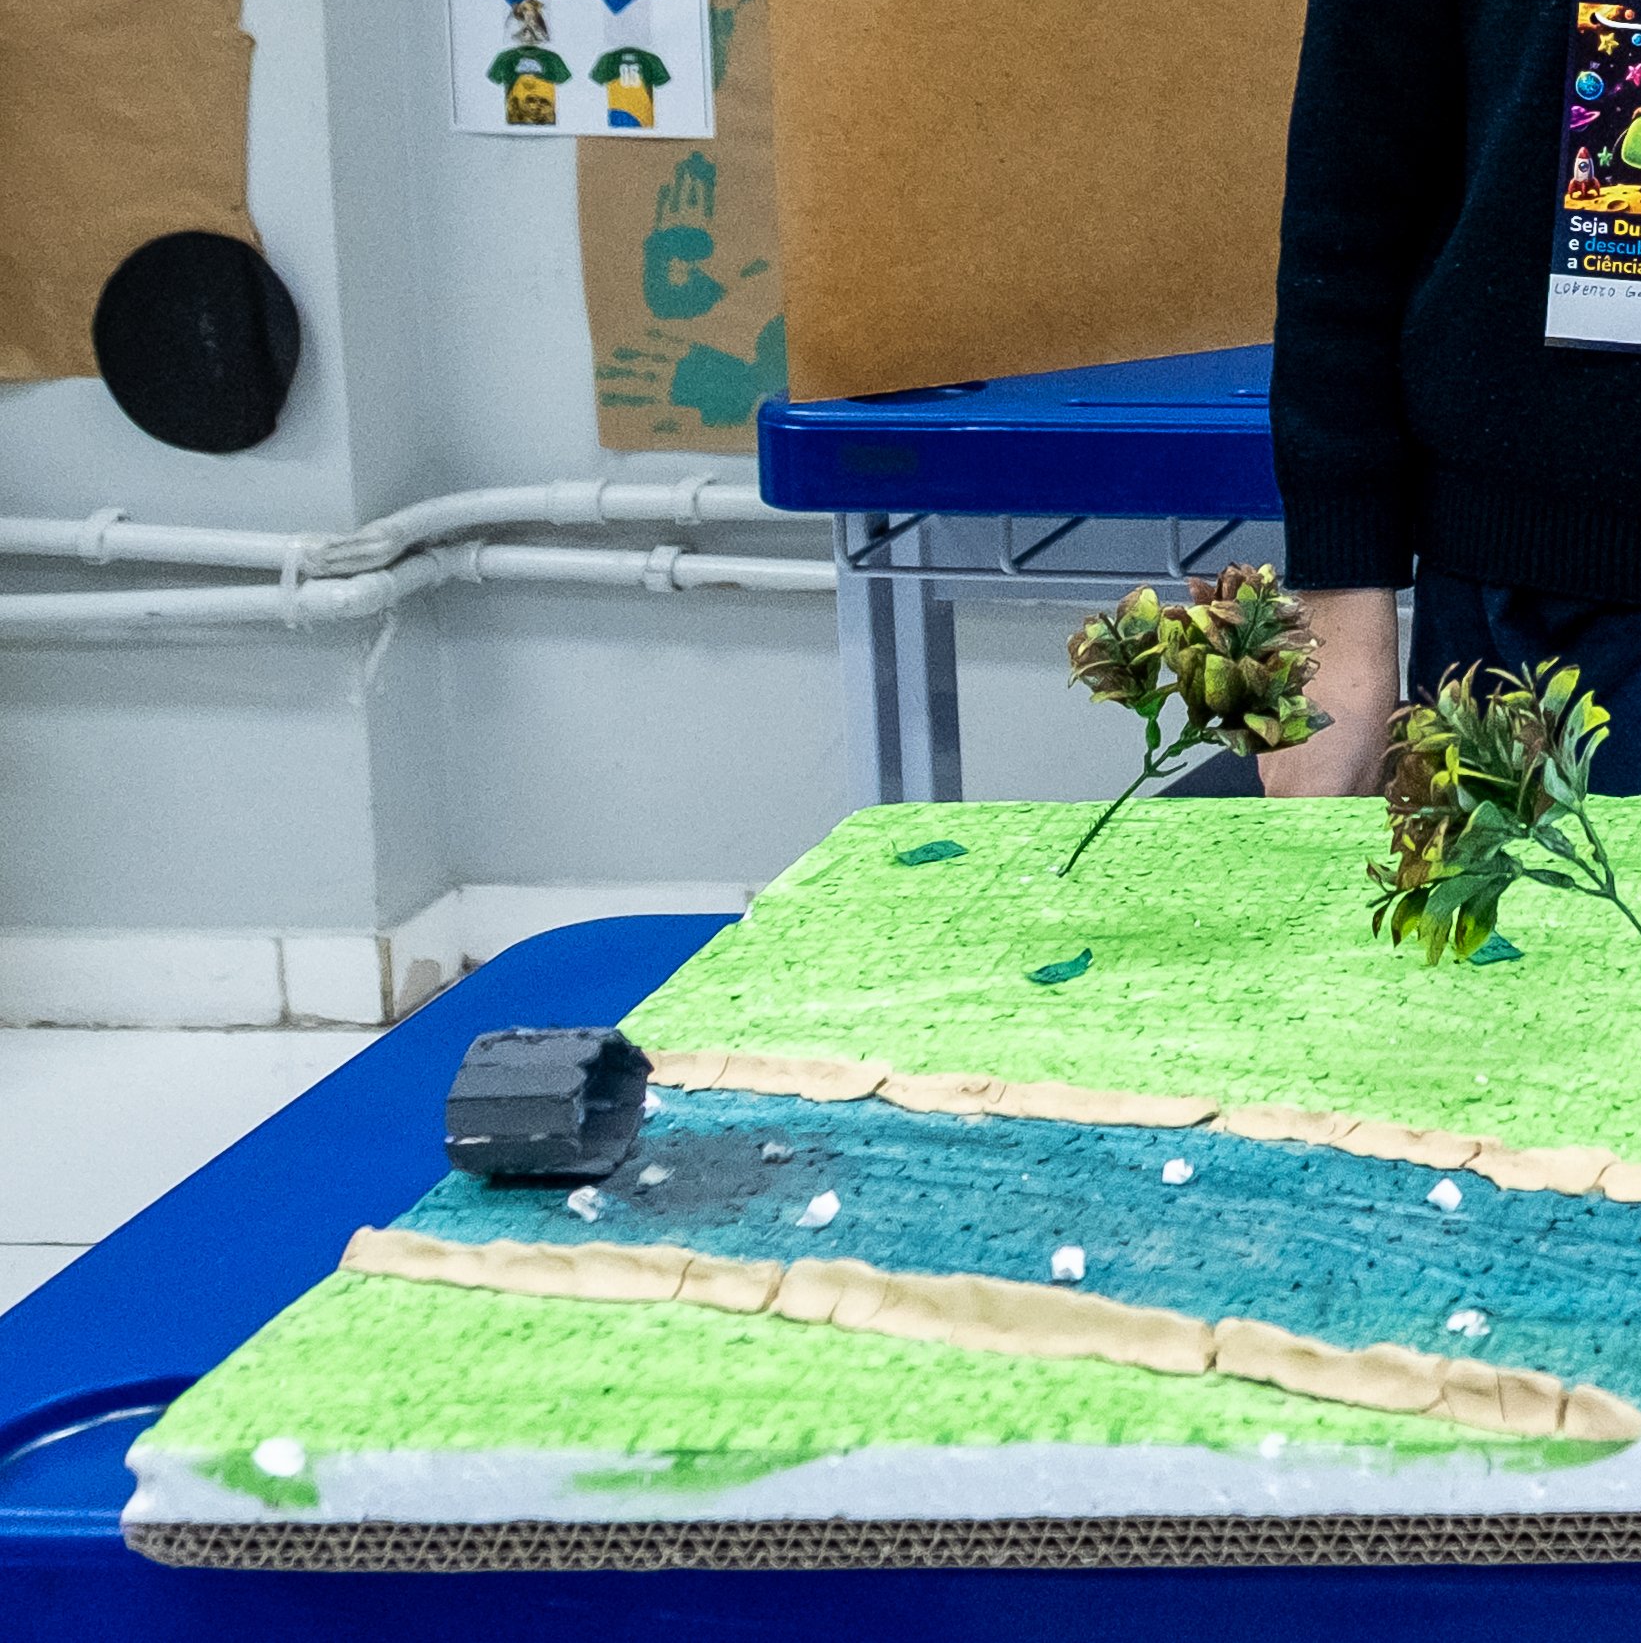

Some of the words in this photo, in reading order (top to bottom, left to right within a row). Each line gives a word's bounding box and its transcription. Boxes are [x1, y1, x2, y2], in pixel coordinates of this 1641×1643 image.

[1570, 216, 1608, 236] Seja
[1568, 239, 1579, 251] e
[1567, 257, 1578, 269] a
